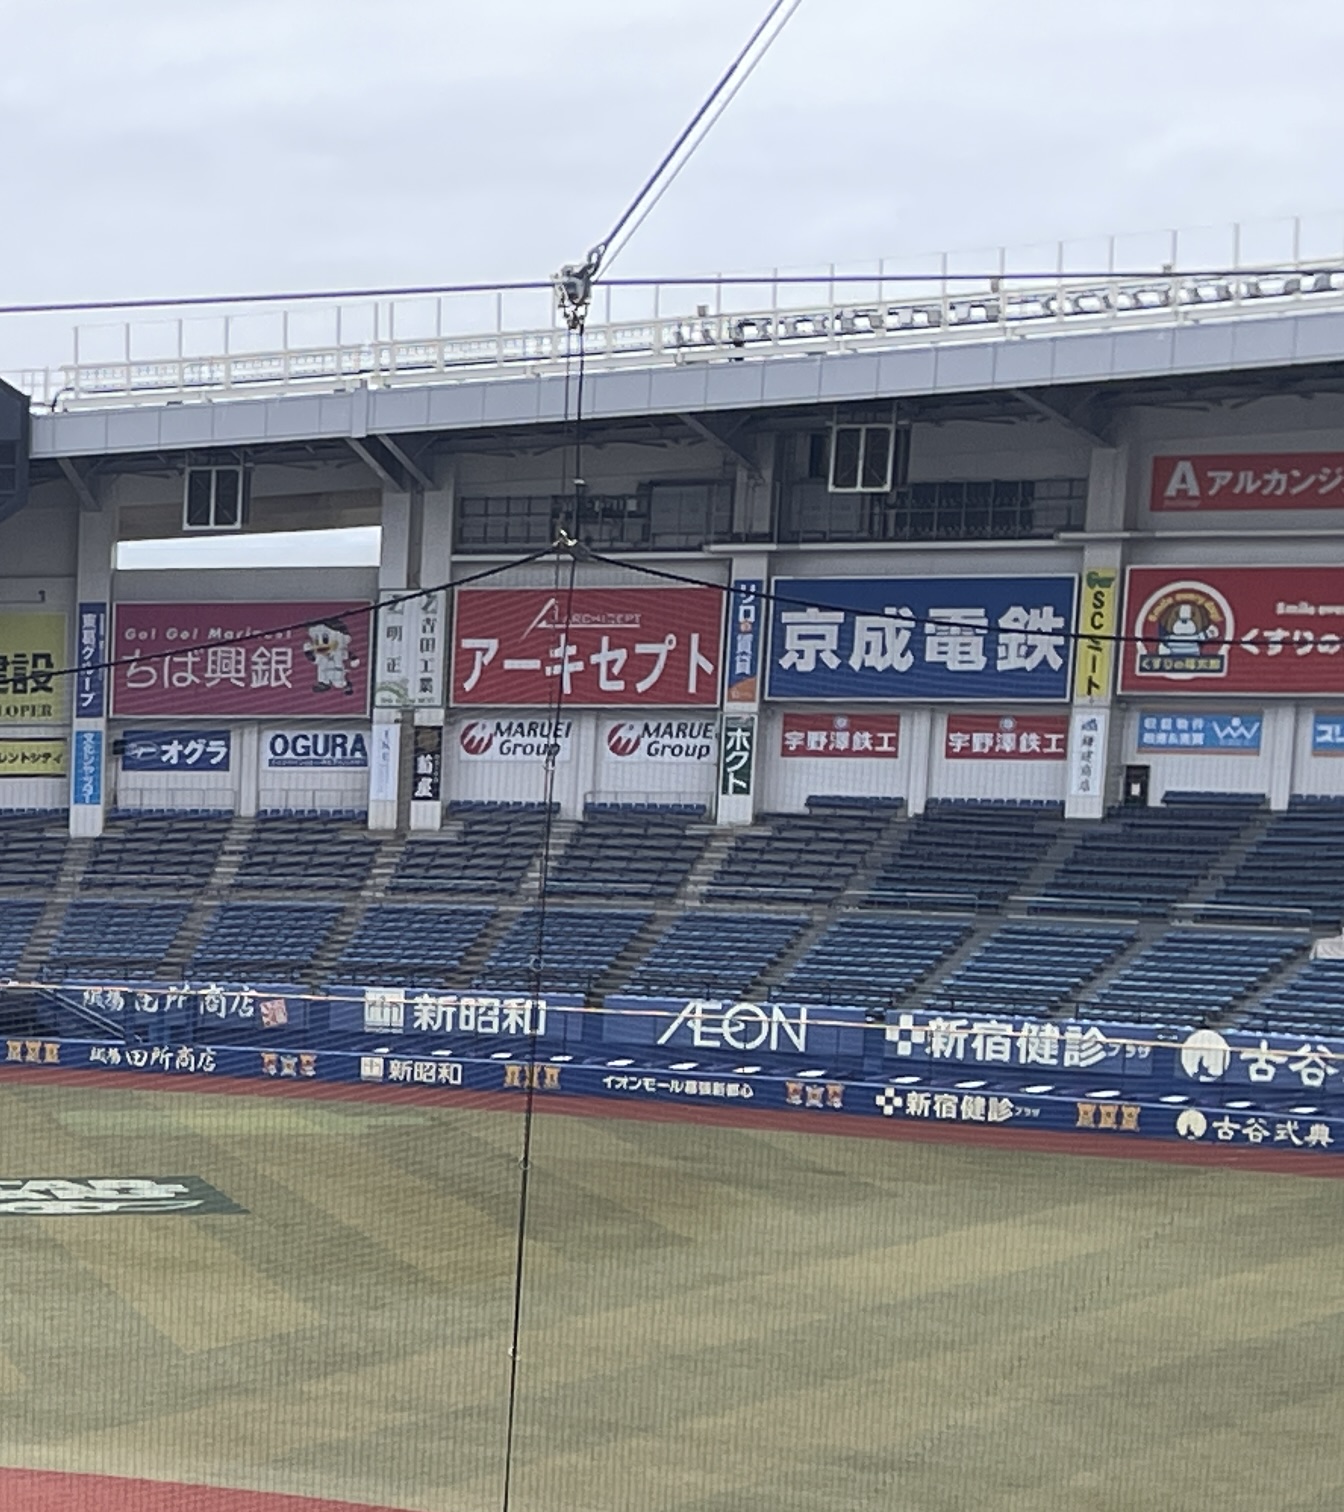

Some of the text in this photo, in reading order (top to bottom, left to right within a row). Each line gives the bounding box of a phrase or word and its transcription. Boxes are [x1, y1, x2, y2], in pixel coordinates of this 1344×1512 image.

[1206, 467, 1344, 496] アルカンジ
[777, 605, 1067, 673] 京成電鉄
[121, 647, 294, 689] ちば興銀
[460, 632, 715, 695] アーキセプト
[494, 721, 572, 738] MARUEI
[161, 739, 231, 766] オグラ
[269, 733, 369, 757] OGURA
[499, 740, 562, 758] Group
[647, 742, 711, 759] Group
[725, 727, 751, 798] ホクト
[413, 992, 548, 1037] 新昭和
[388, 1058, 463, 1087] 新昭和
[1212, 1114, 1335, 1148] 古谷式典
